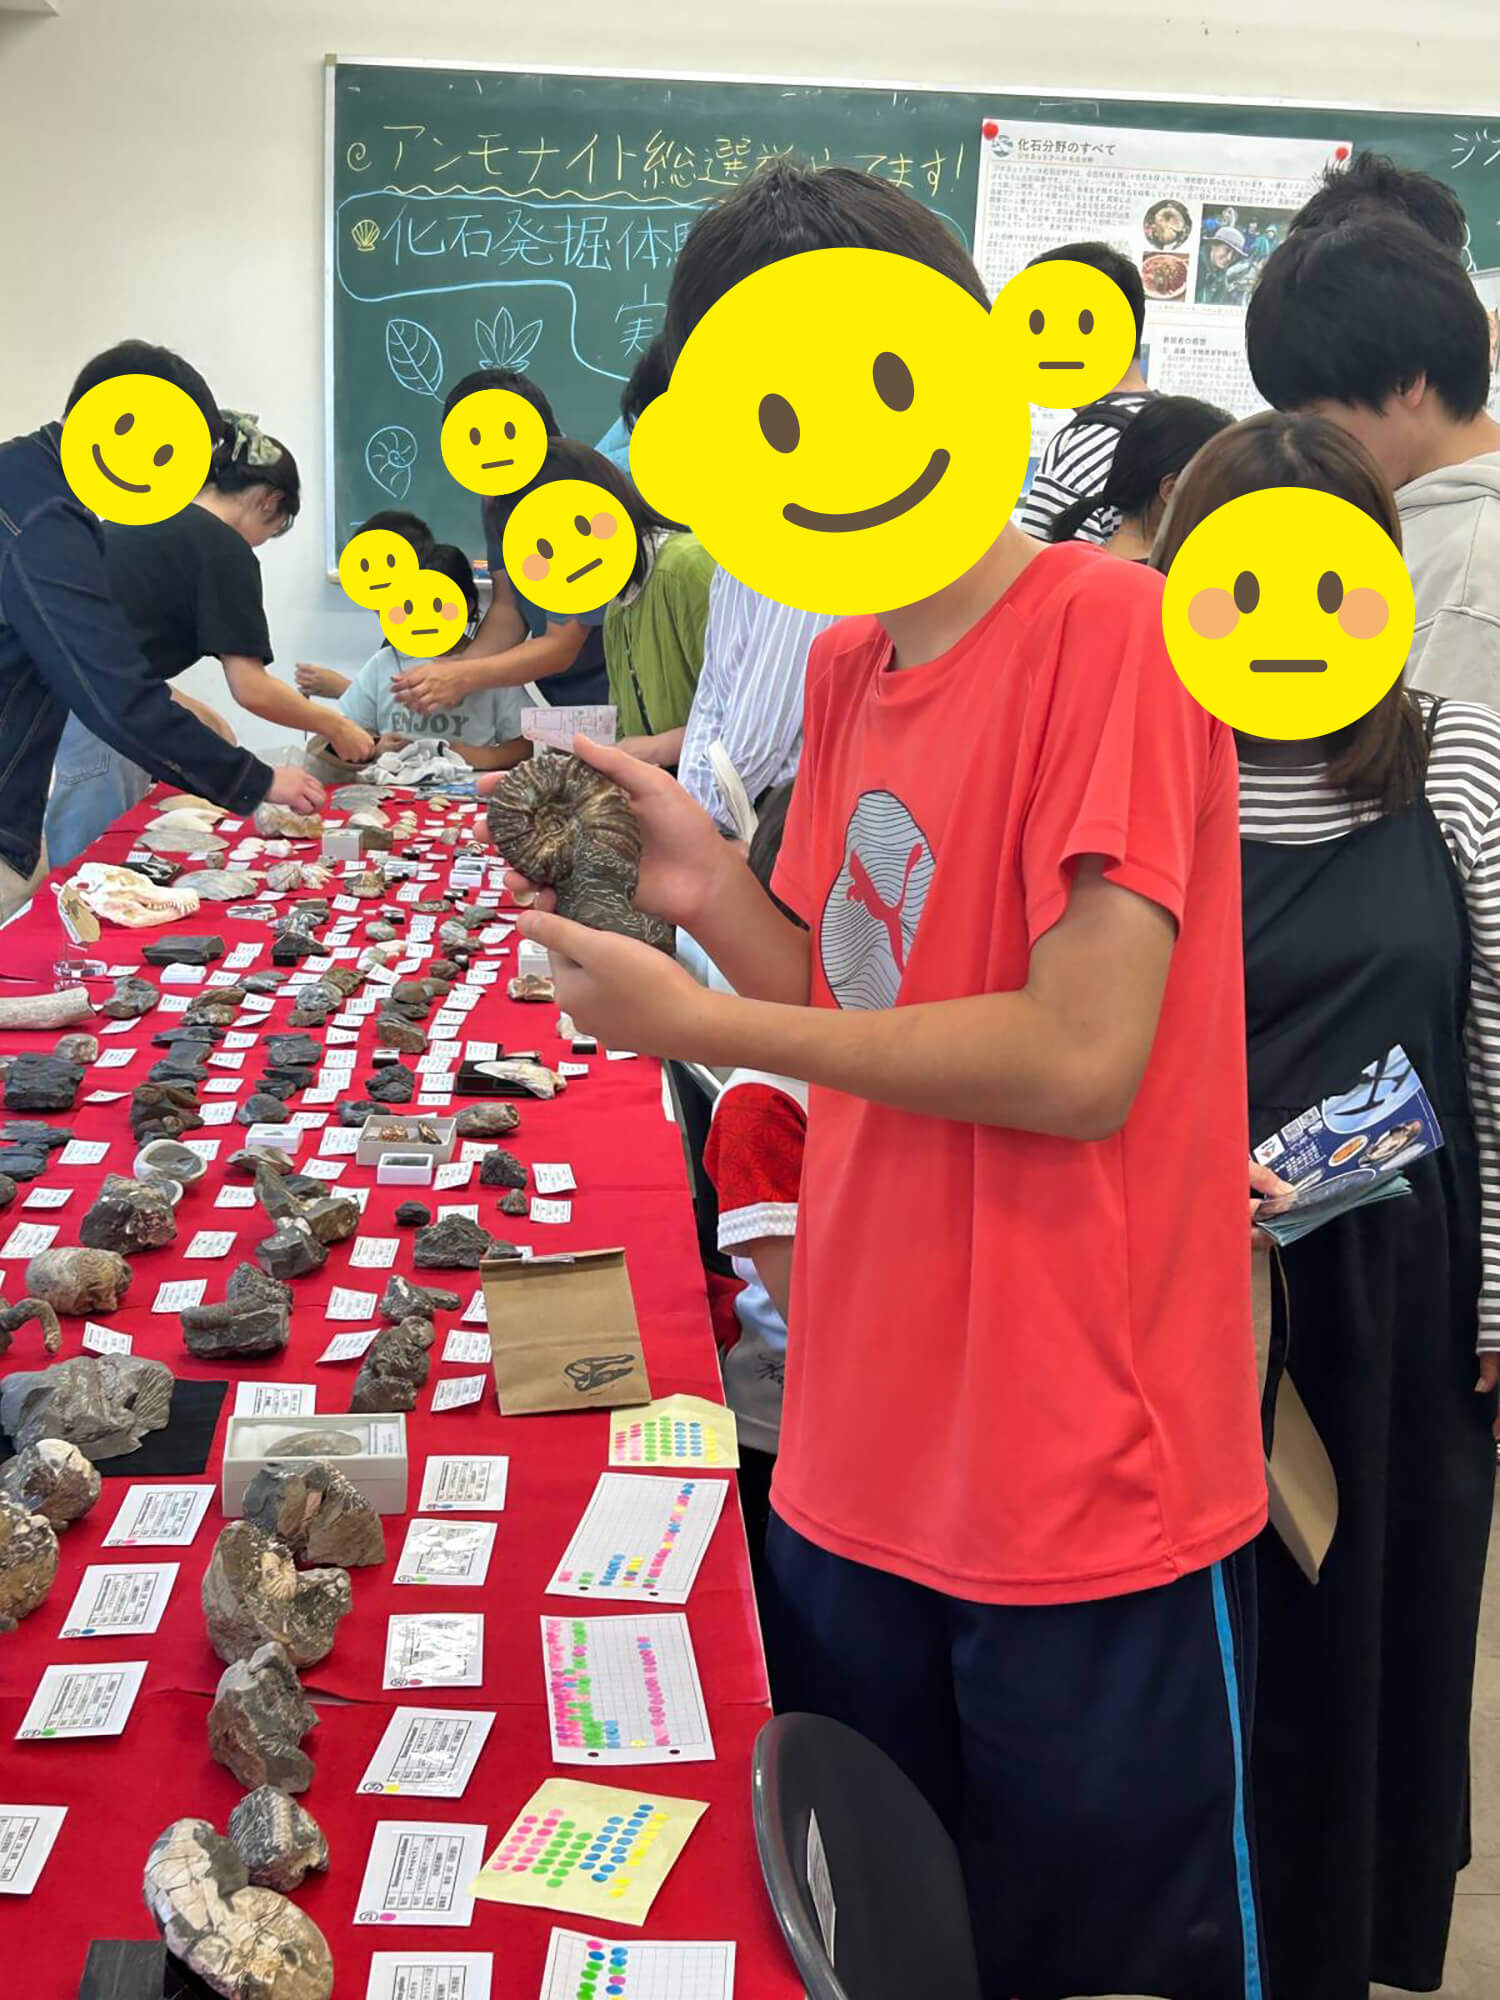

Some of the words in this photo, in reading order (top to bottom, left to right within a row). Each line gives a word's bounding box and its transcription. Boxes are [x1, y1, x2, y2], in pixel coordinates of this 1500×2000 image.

[1017, 138, 1117, 156] 化石分野のすべて
[391, 711, 470, 737] ENJOY
